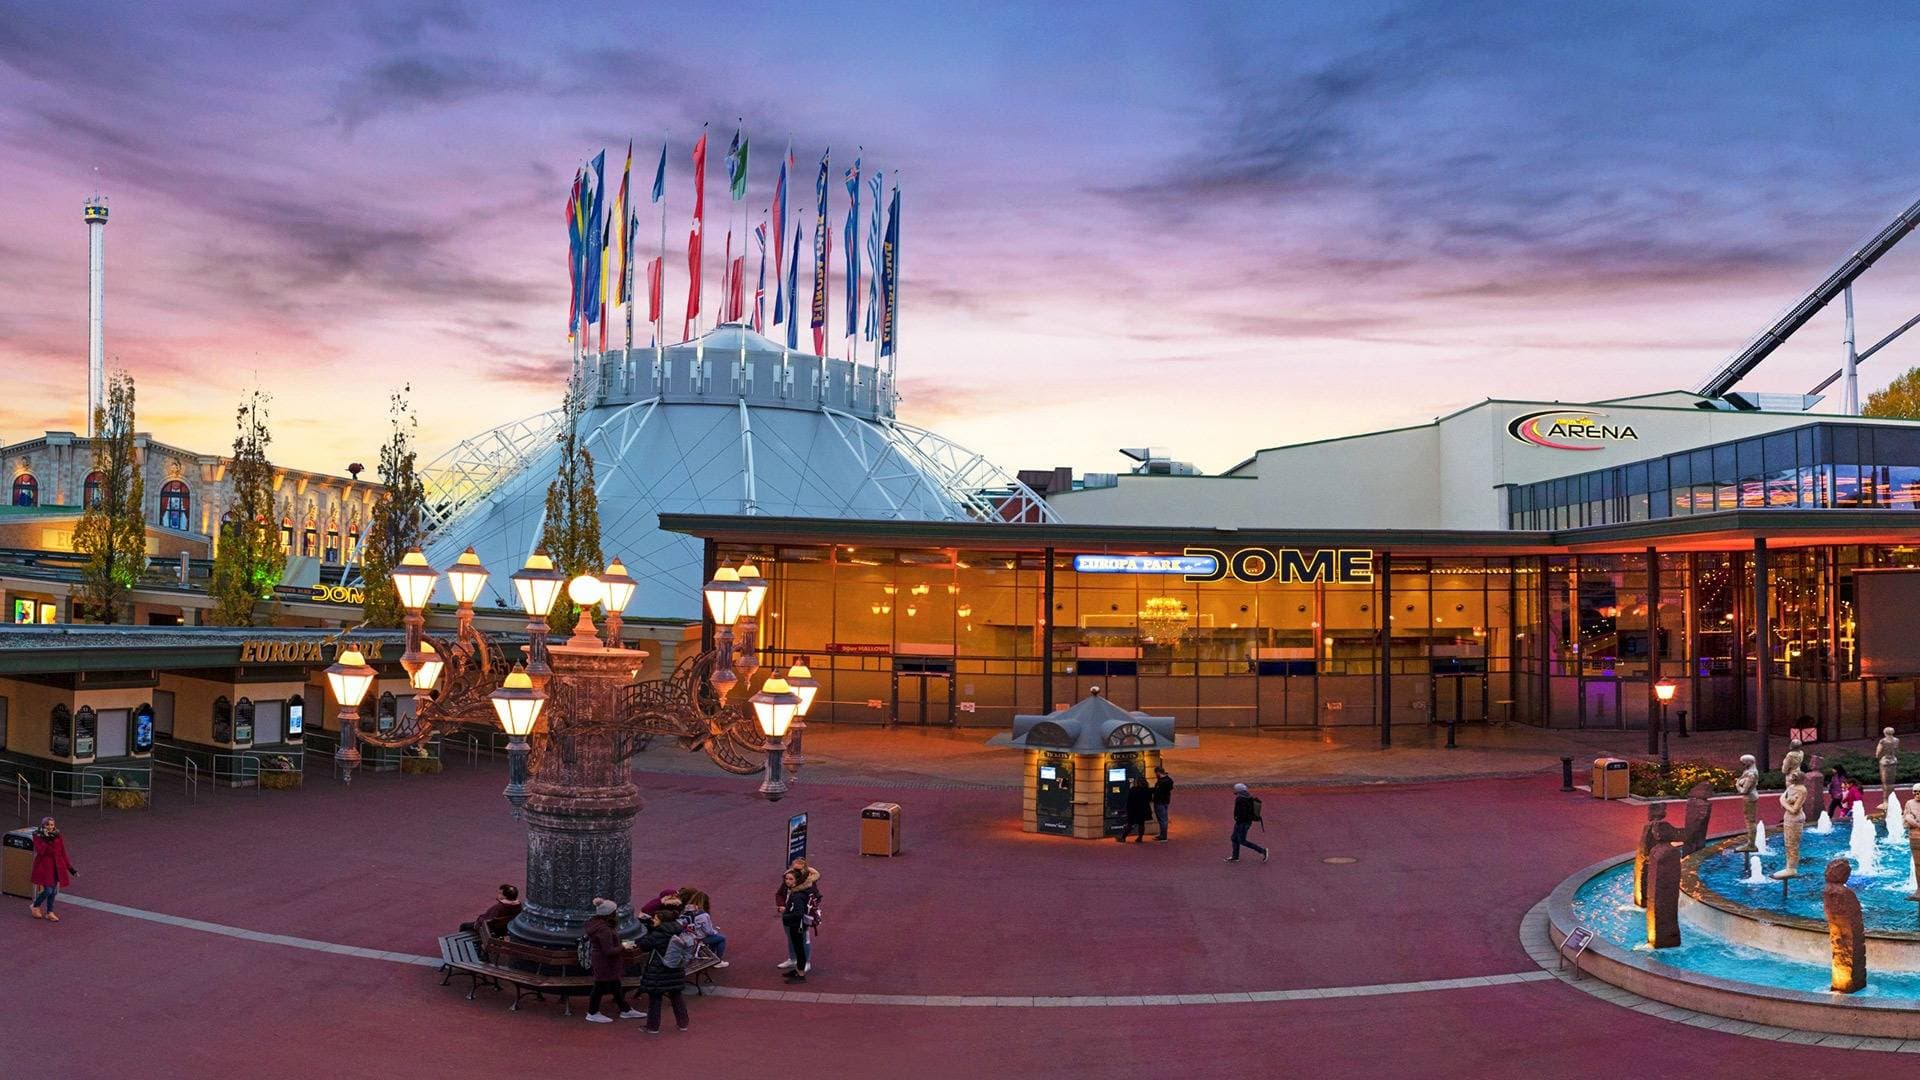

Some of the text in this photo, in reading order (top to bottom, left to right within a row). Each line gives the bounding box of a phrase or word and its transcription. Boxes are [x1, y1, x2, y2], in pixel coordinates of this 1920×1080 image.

[1547, 424, 1639, 440] ARENA
[1079, 559, 1183, 571] EUROPA PARK
[1183, 547, 1374, 584] DOME
[312, 584, 367, 605] DOM
[240, 639, 384, 663] EUROPA PRK
